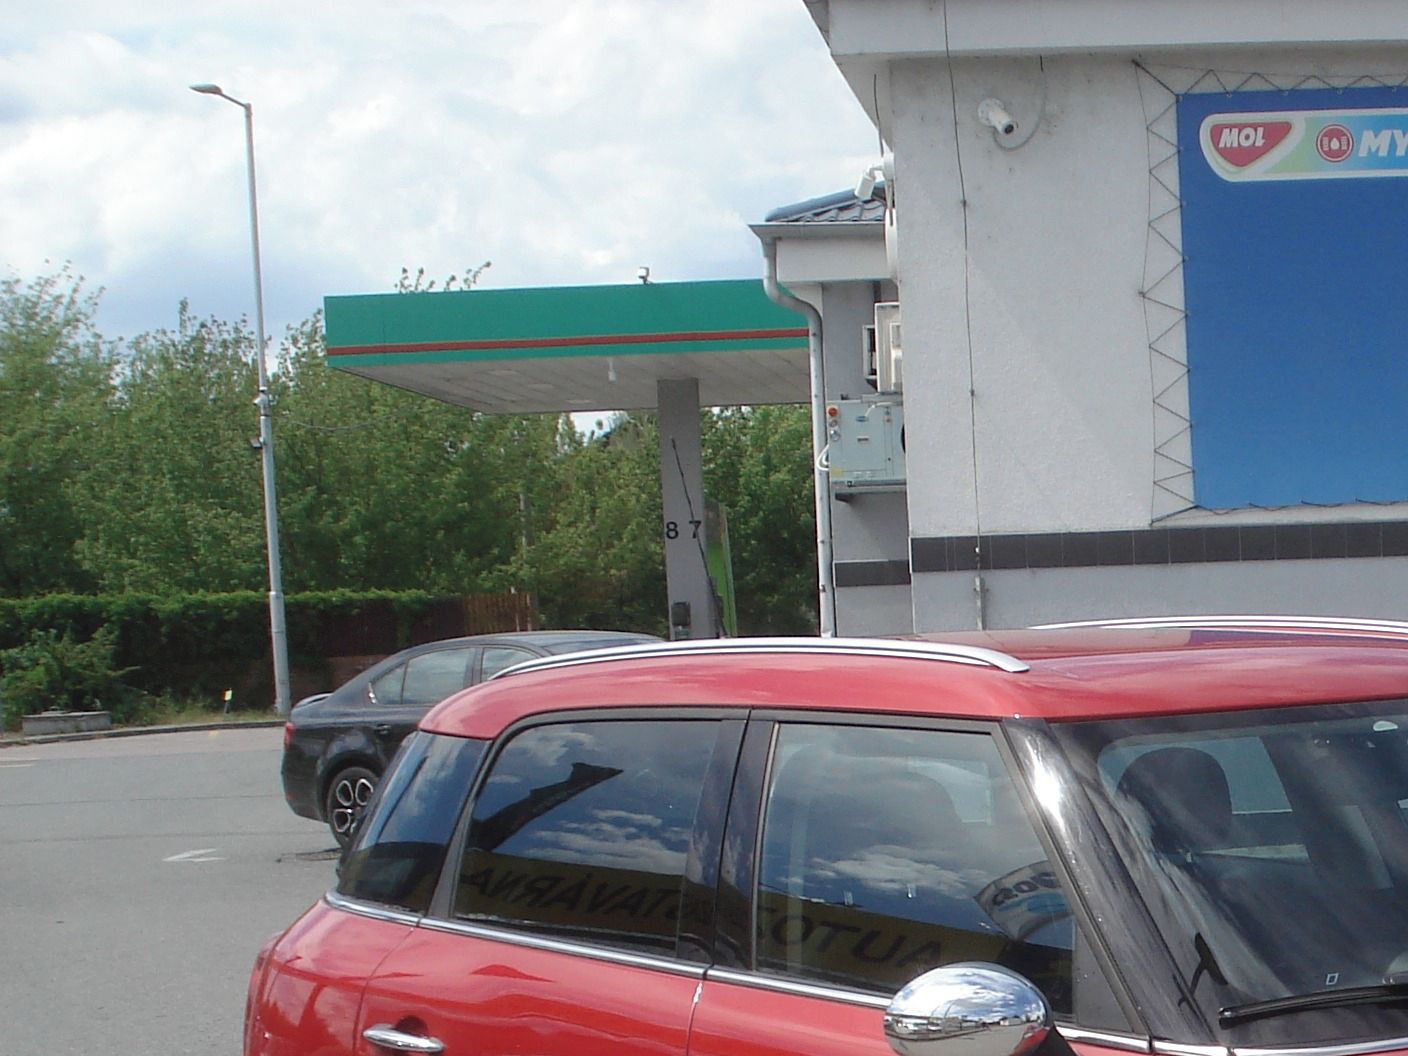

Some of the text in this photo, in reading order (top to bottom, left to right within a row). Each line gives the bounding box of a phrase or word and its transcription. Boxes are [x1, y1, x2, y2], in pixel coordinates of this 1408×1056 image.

[1218, 127, 1266, 148] MOL
[666, 520, 701, 539] 8 7
